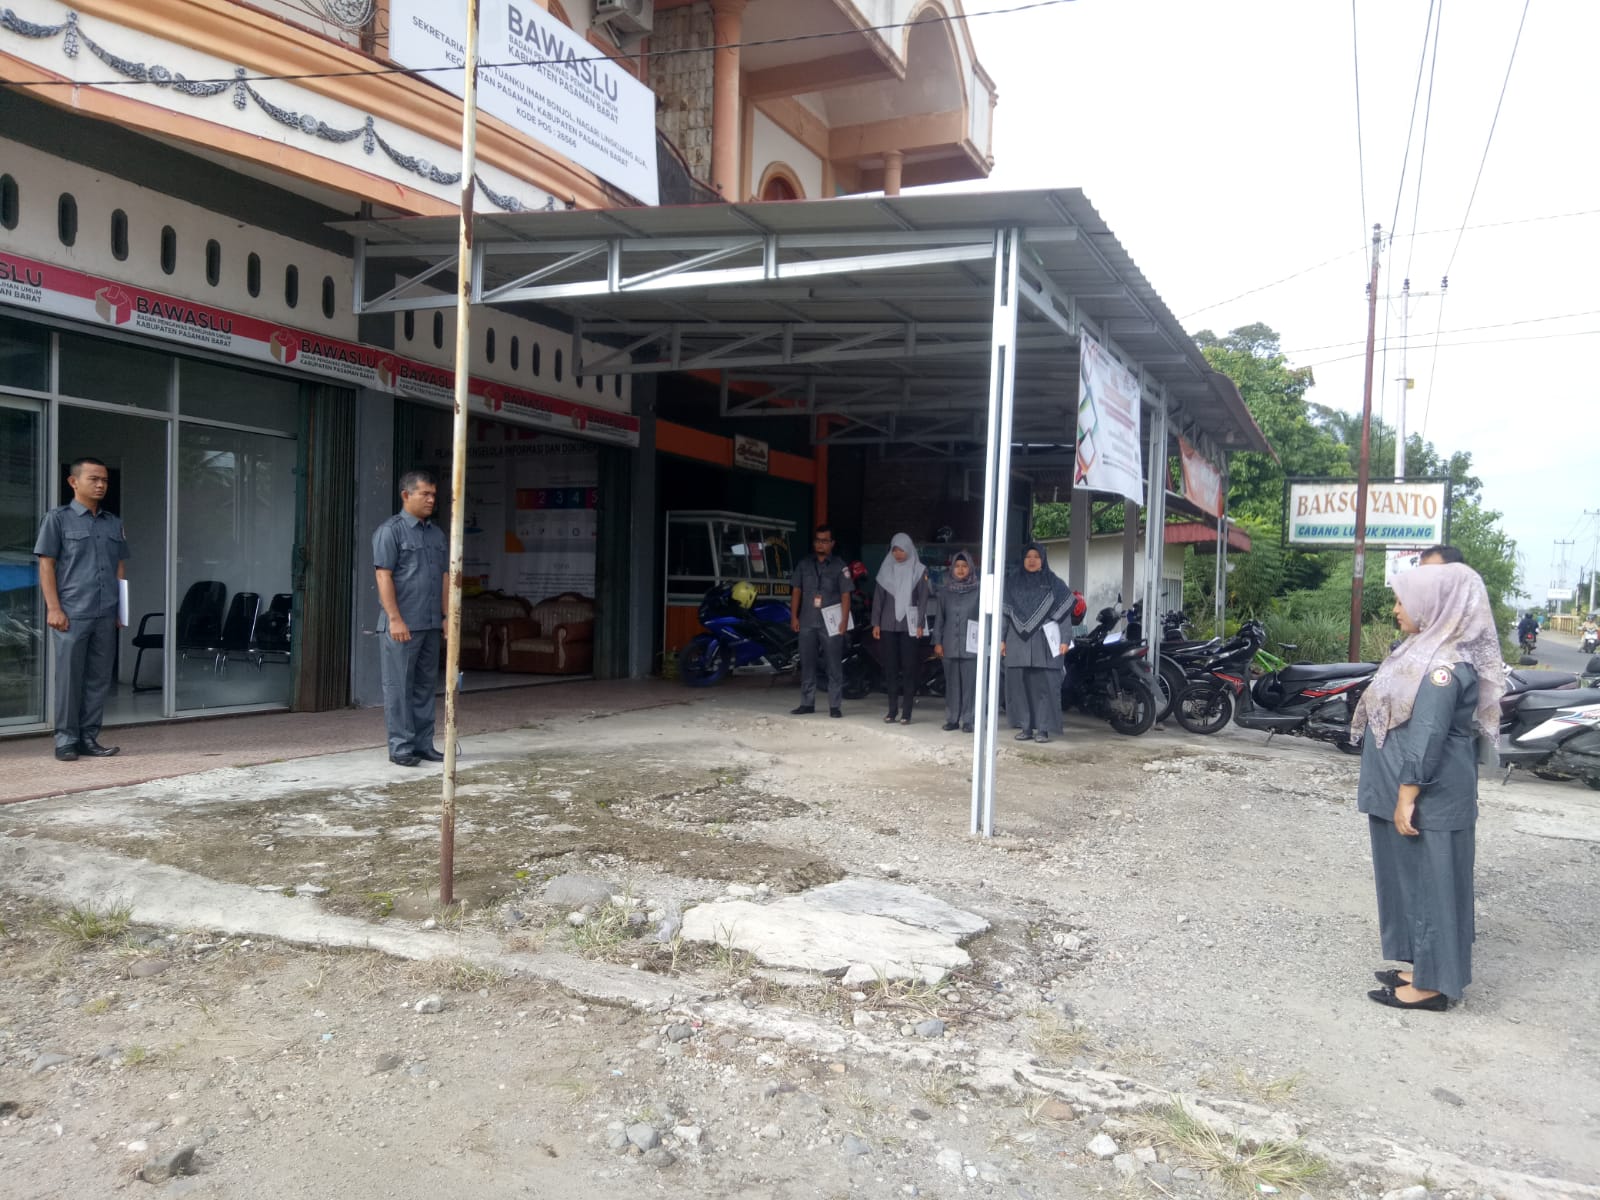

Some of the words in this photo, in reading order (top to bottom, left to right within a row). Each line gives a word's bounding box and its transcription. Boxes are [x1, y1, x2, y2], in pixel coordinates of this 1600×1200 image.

[508, 4, 618, 102] BAWASLU
[509, 34, 532, 55] BADAN
[412, 16, 467, 55] SEKRETARIA
[494, 66, 525, 90] TUANKU
[526, 86, 546, 104] IMAM
[577, 117, 600, 137] NAGARI
[559, 78, 595, 109] PASAMAN
[596, 102, 618, 125] BARAT
[516, 106, 537, 125] KODE
[538, 120, 553, 134] POS
[537, 106, 578, 136] KABUPATEN
[578, 131, 609, 156] PASAMAN
[609, 150, 628, 168] BARAT
[14, 291, 42, 303] BARAT
[20, 286, 42, 296] UMUM
[136, 297, 232, 334] BAWASLU
[136, 320, 177, 335] KABUPATEN
[178, 330, 210, 342] PASAMAN
[210, 337, 232, 347] BARAT
[300, 359, 333, 371] KABUPATEN
[301, 338, 376, 369] BAWASLU
[400, 364, 455, 391] BAWASL
[1369, 490, 1437, 520] YANTO
[1297, 526, 1339, 536] CABANG
[1343, 526, 1378, 537] LUUK
